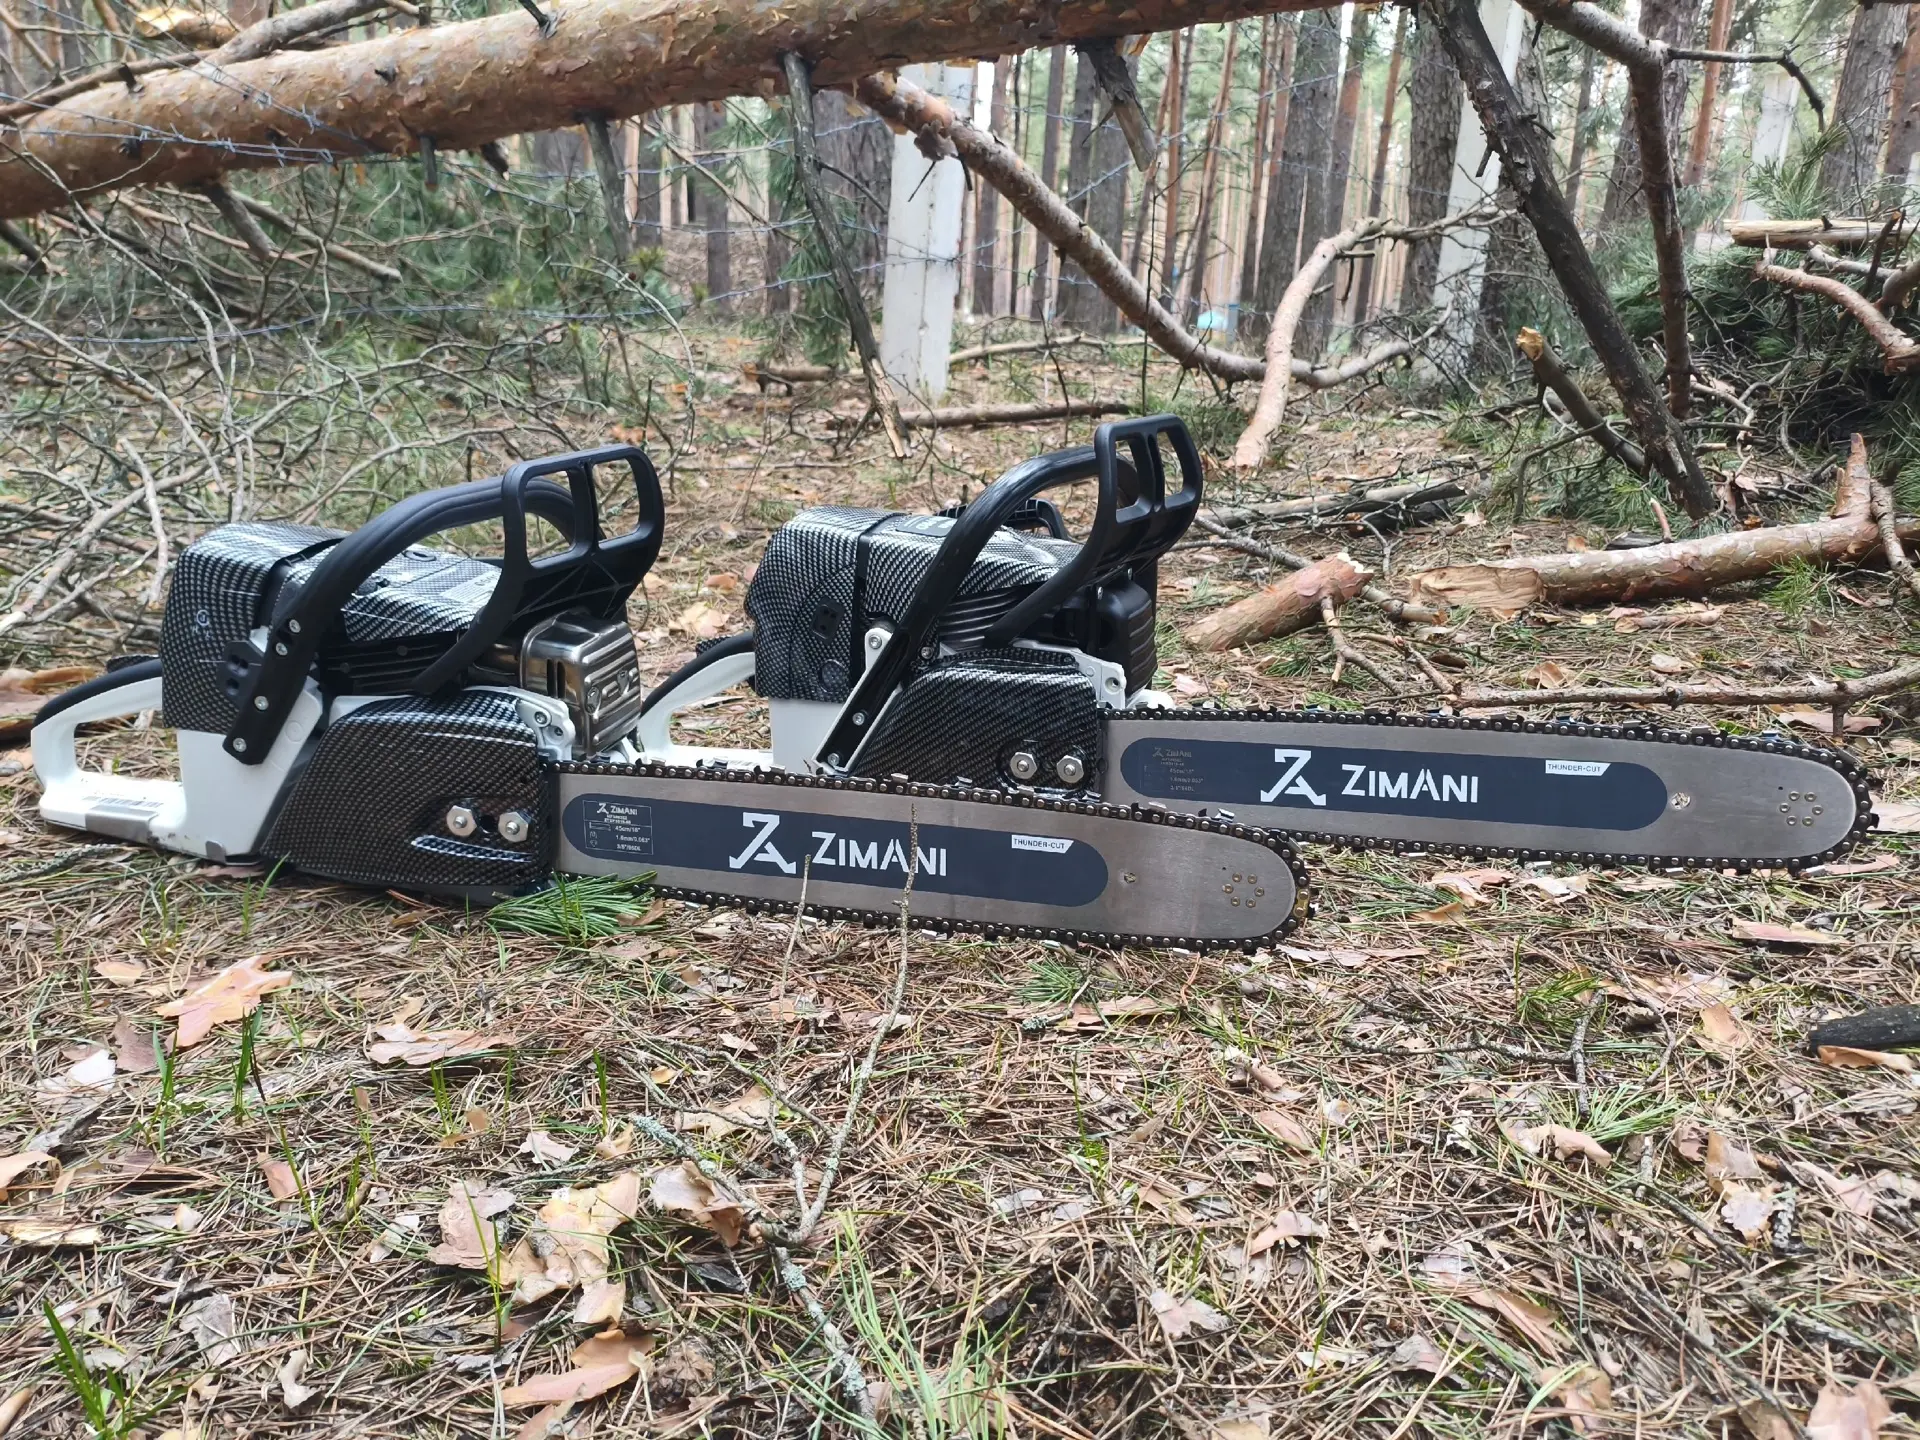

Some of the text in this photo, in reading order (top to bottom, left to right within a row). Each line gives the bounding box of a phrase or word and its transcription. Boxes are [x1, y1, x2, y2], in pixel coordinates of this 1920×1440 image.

[1547, 763, 1602, 773] THUNDER-CUT
[1341, 763, 1479, 803] ZIMANI
[610, 805, 637, 815] ZIMANI
[1013, 838, 1066, 850] THUNDER-CUT
[811, 831, 947, 877] ZIMANI
